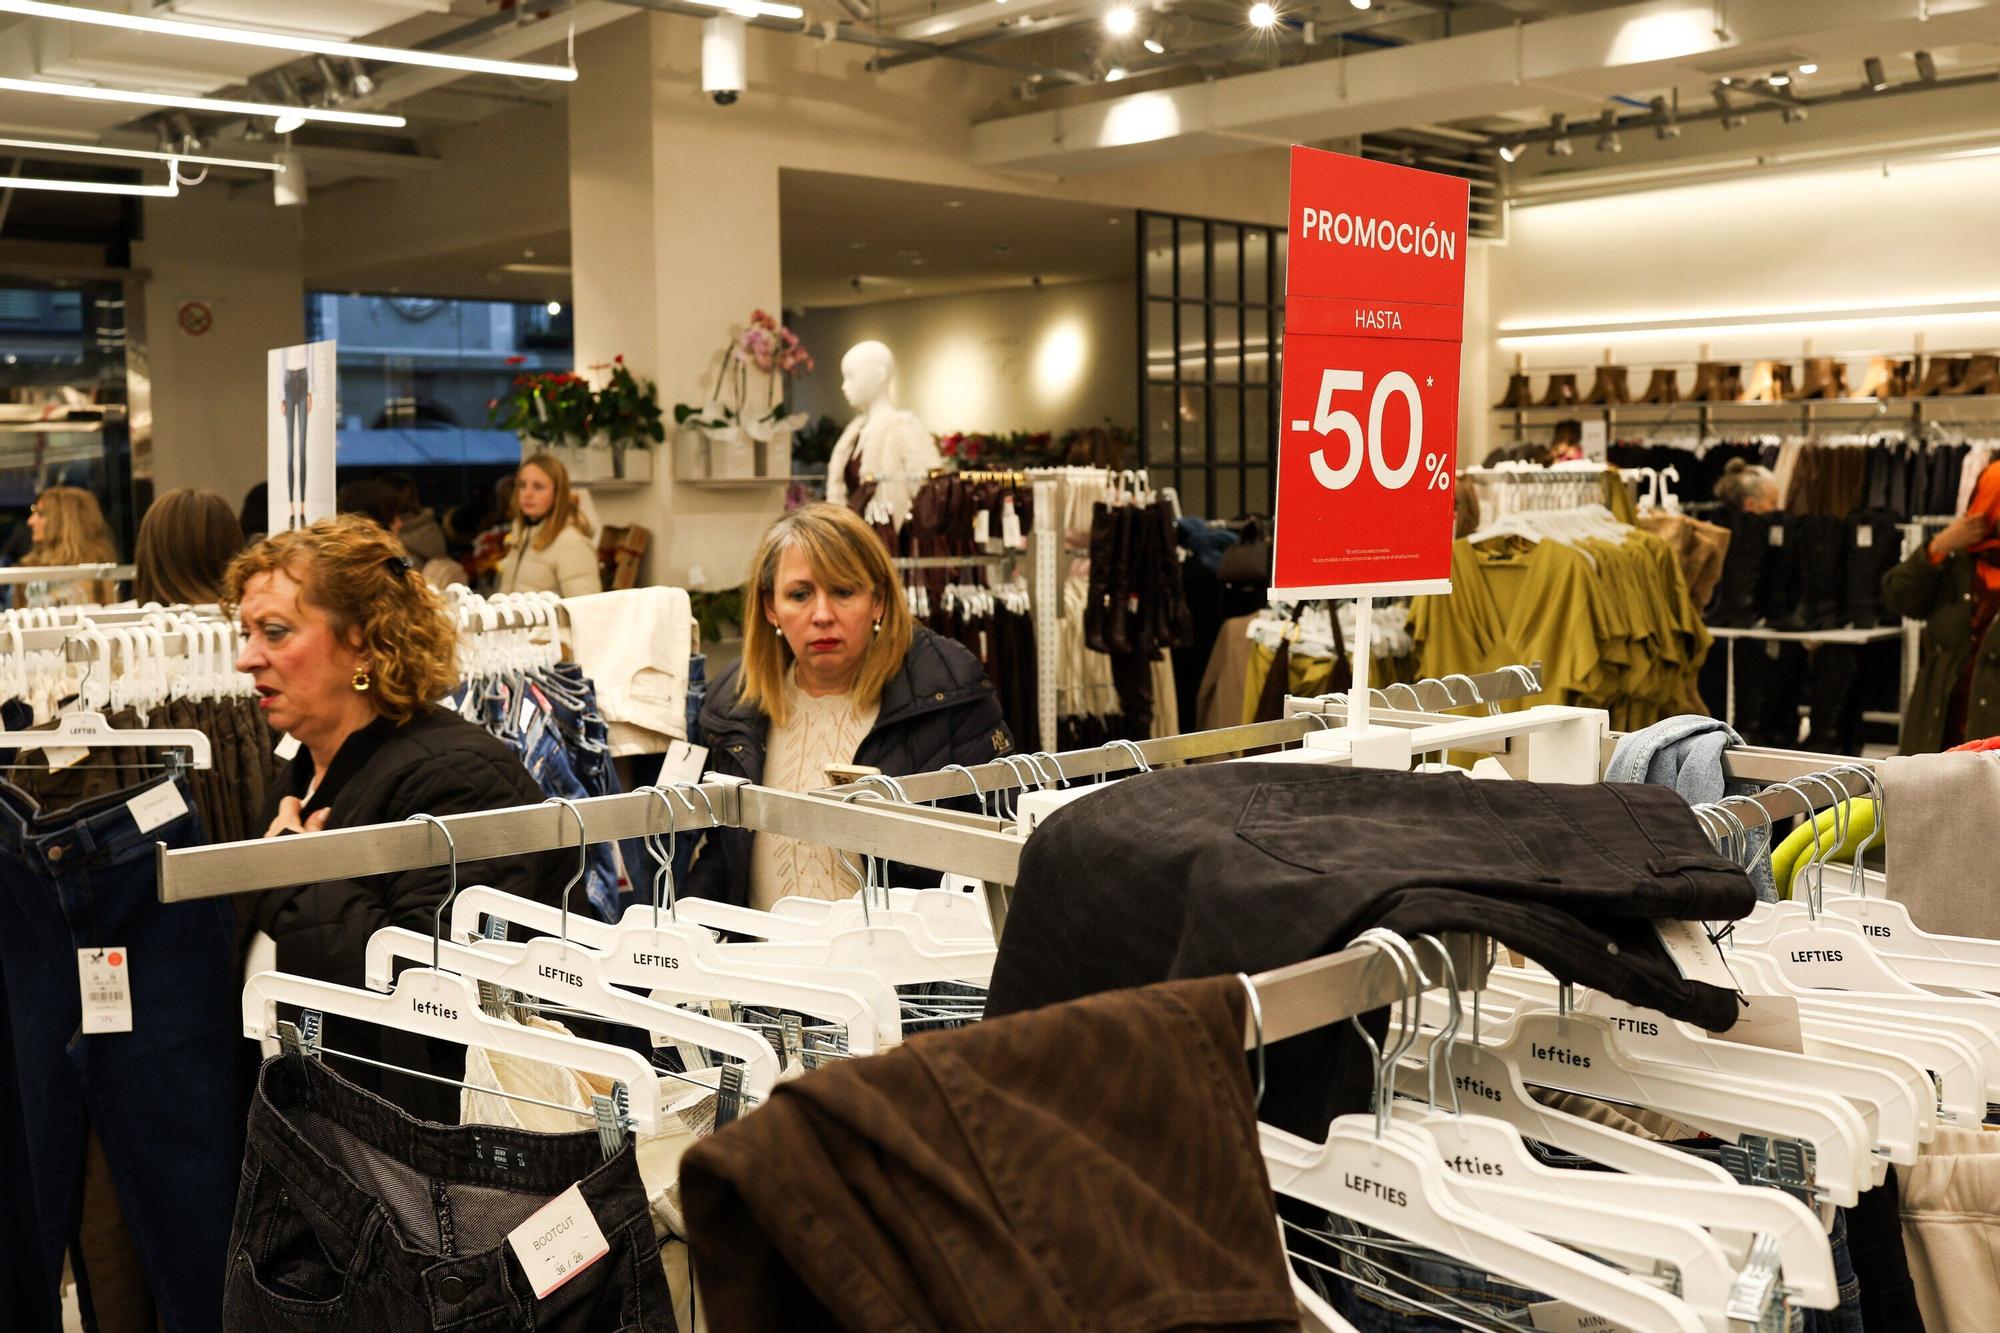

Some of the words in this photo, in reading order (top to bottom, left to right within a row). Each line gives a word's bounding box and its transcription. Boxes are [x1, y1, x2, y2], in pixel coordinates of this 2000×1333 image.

[1302, 207, 1456, 261] PROMOCIÓN
[1355, 309, 1402, 330] HASTA
[1862, 924, 1891, 938] TIES
[633, 952, 680, 970] LEFTIES
[1791, 949, 1844, 963] LEFTIES
[538, 964, 584, 988] LEFTIES
[412, 998, 458, 1020] lefties
[1610, 1017, 1659, 1036] FTIES
[1531, 1042, 1591, 1068] lefties
[1456, 1076, 1502, 1102] efties
[1444, 1156, 1504, 1176] fties
[1345, 1172, 1408, 1207] LEFTIES
[532, 1215, 575, 1251] BOOTCUT
